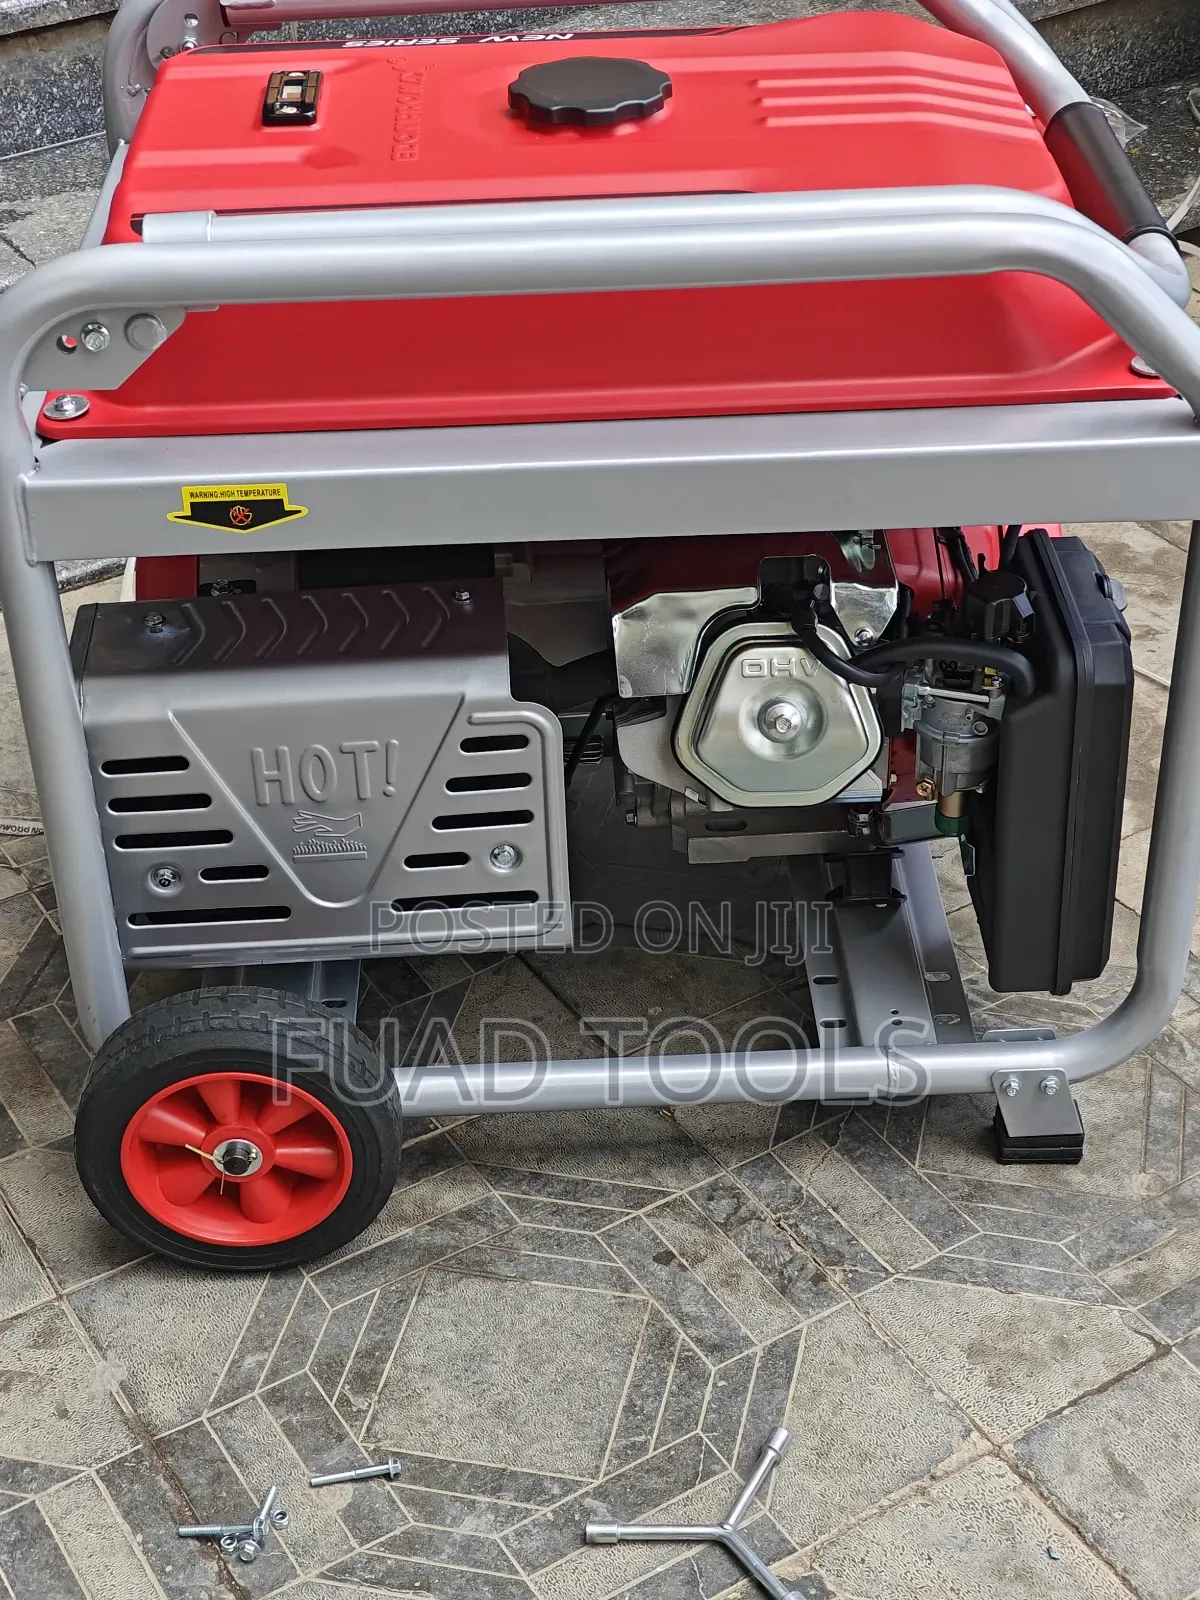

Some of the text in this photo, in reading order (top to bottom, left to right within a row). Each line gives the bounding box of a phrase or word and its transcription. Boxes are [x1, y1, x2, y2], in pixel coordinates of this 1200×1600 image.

[342, 33, 574, 48] NEW SERIES
[236, 488, 281, 497] TEMPERATURE
[741, 657, 820, 678] OHV
[250, 739, 399, 806] HOT!
